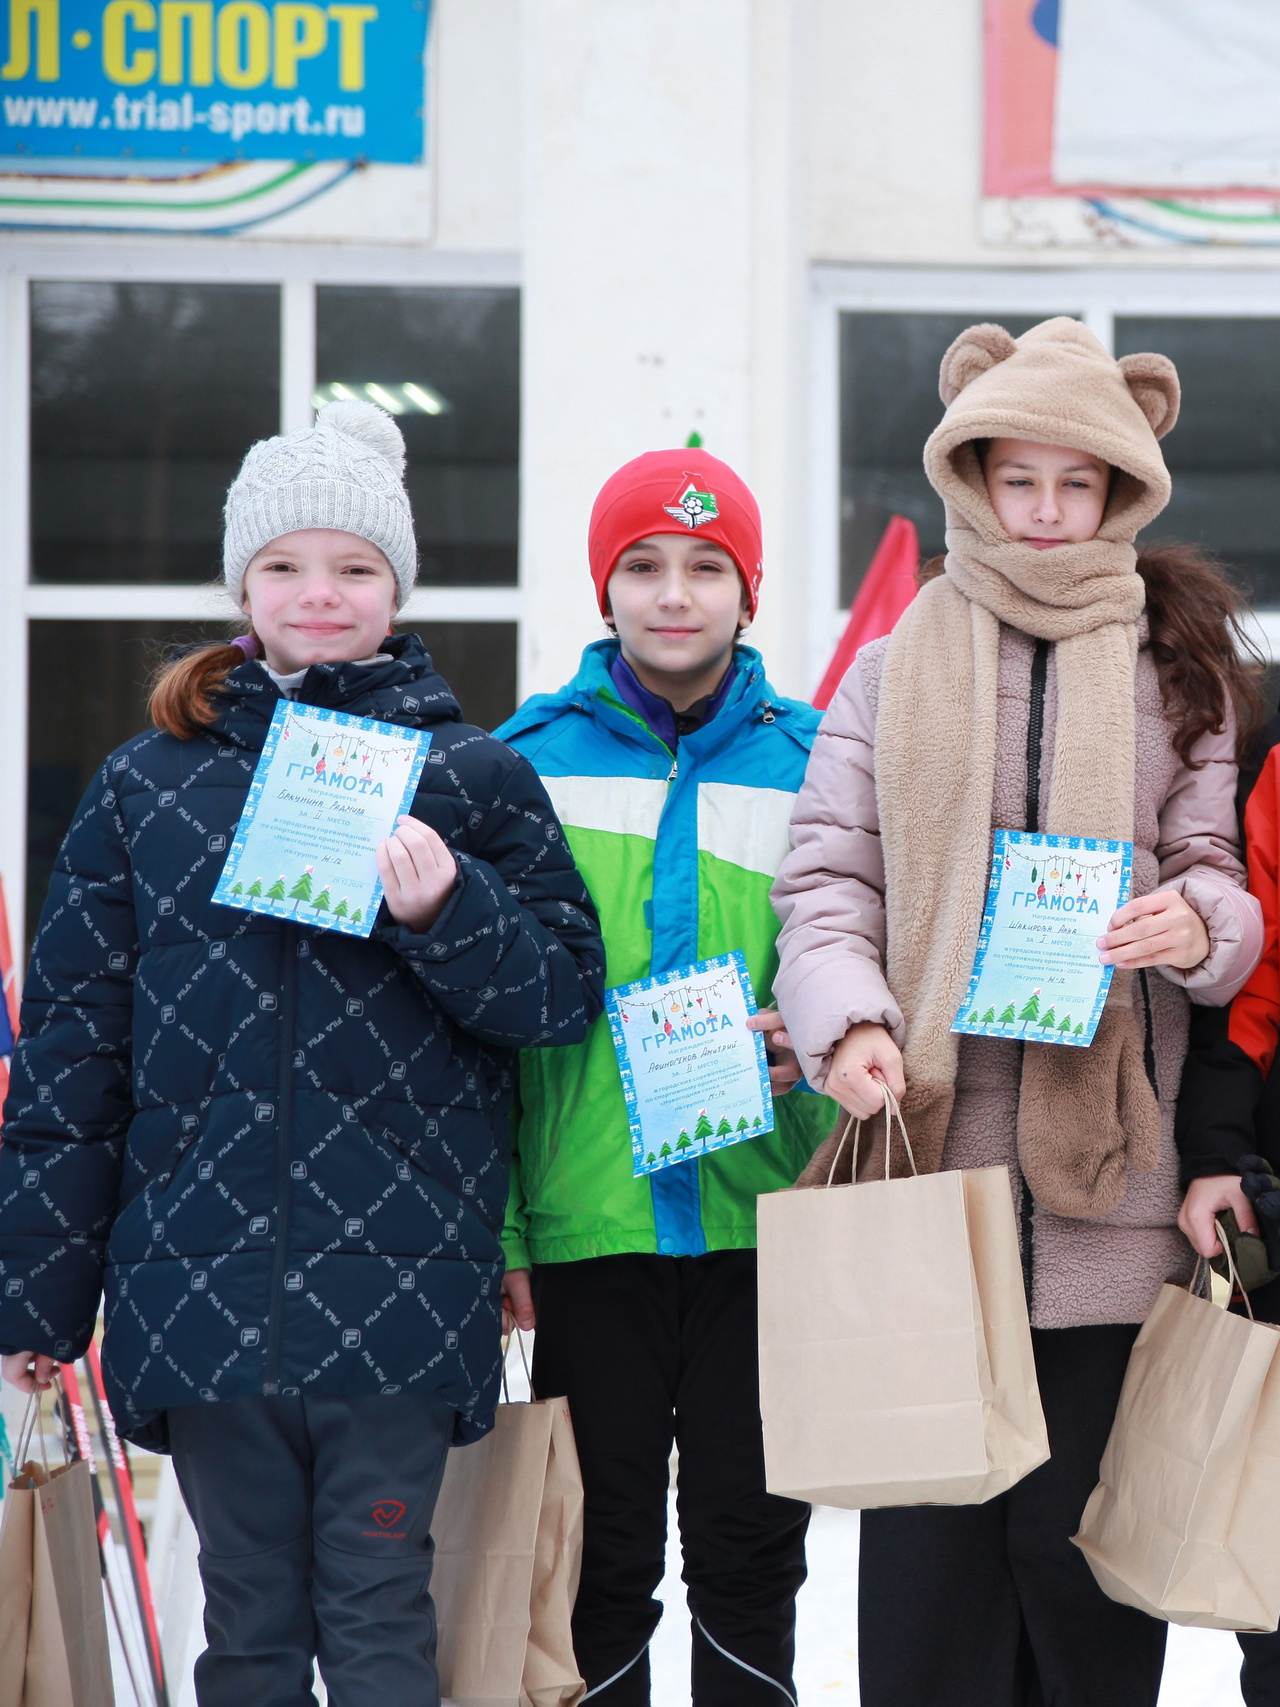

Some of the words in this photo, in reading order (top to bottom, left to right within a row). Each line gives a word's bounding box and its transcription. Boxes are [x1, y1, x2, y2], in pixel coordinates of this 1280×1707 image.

[4, 91, 366, 142] www.trial-sport.ru
[225, 678, 241, 688] FILA
[129, 768, 142, 780] FILA
[285, 762, 386, 798] ГРАМОТА
[307, 787, 357, 803] Награждается
[177, 807, 192, 822] FILA
[326, 816, 350, 826] МЕСТО
[270, 825, 317, 840] спортивному
[318, 835, 377, 853] ориентировани
[278, 819, 315, 831] городских
[316, 827, 370, 843] соревнованиях
[292, 850, 317, 861] группе
[319, 844, 339, 853] гонка
[175, 875, 191, 892] FILA
[1011, 891, 1101, 914] ГРАМОТА
[81, 911, 93, 927] FILA
[1032, 913, 1076, 923] Награждается
[455, 935, 473, 947] FILA
[1001, 954, 1043, 964] спортивному
[1009, 947, 1041, 956] городских
[1042, 950, 1090, 961] соревнованиях
[226, 959, 240, 974] FILA
[312, 959, 328, 976] FILA
[1022, 975, 1044, 983] группе
[176, 983, 192, 1000] FILA
[179, 1024, 195, 1040] FILA
[366, 1020, 379, 1039] FILA
[641, 1011, 732, 1052] ГРАМОТА
[307, 1033, 325, 1049] FILA
[668, 1037, 714, 1055] Награждается
[697, 1058, 718, 1069] МЕСТО
[658, 1078, 691, 1092] городских
[693, 1062, 741, 1082] соревнованиях
[654, 1084, 696, 1101] спортивному
[701, 1083, 719, 1093] гонка
[683, 1098, 704, 1109] группе
[218, 1141, 234, 1158] FILA
[309, 1141, 326, 1159] FILA
[215, 1182, 230, 1199] FILA
[309, 1181, 325, 1199] FILA
[367, 1200, 383, 1216] FILA
[208, 1292, 222, 1310] FILA
[417, 1292, 430, 1310] FILA
[364, 1309, 381, 1326] FILA
